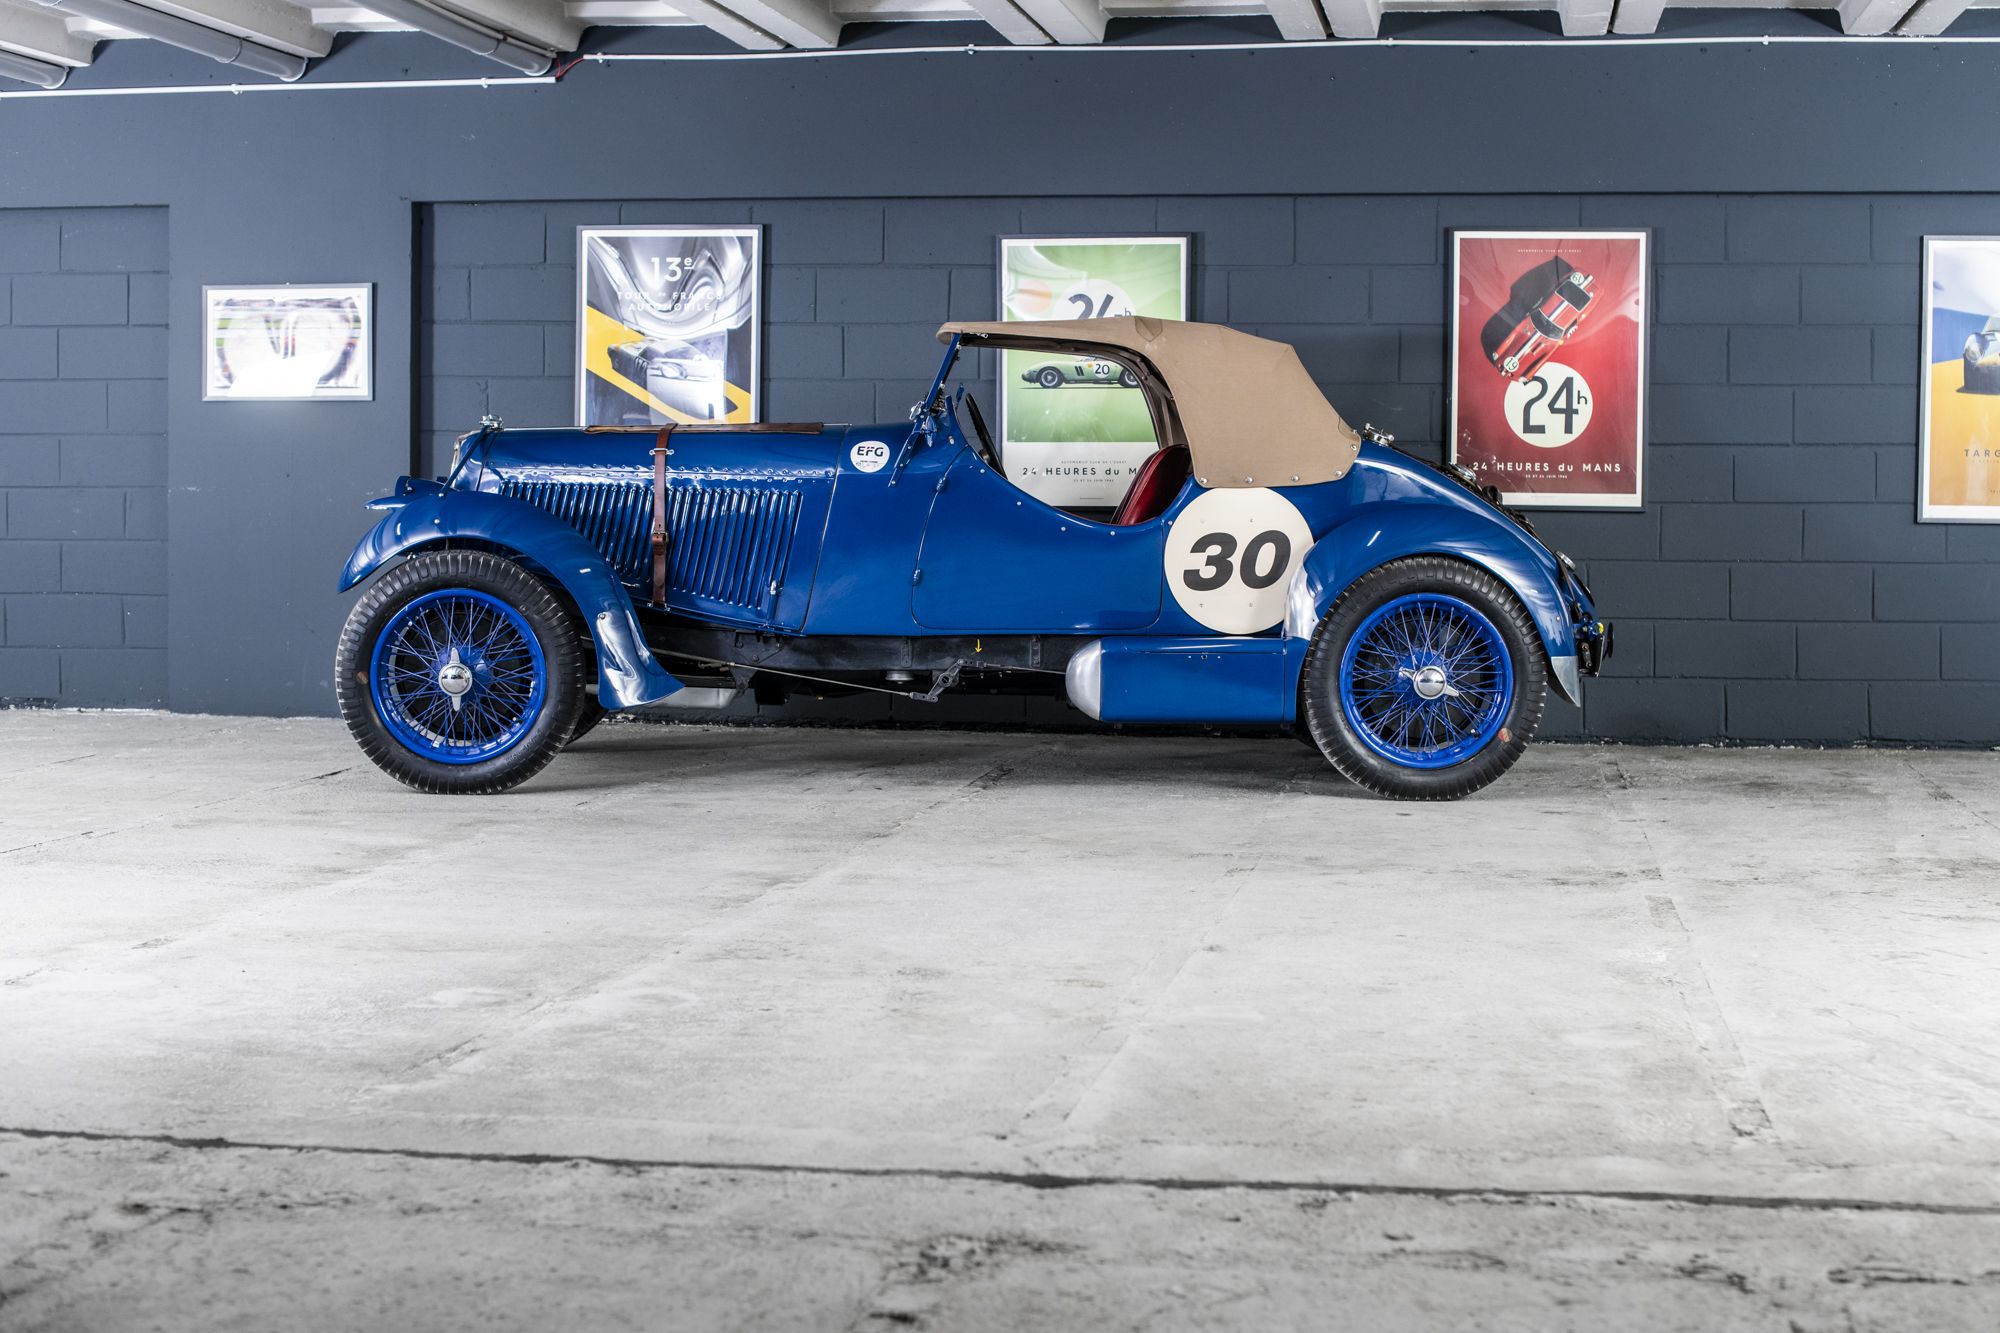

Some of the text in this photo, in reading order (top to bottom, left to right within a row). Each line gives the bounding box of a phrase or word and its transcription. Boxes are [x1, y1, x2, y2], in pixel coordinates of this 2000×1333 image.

[672, 292, 722, 300] FRACE
[628, 303, 710, 311] AUMOBILE
[1095, 363, 1110, 375] 20
[857, 446, 884, 457] EFG
[1022, 467, 1037, 476] 24
[1045, 467, 1097, 476] HEURES
[1105, 467, 1120, 476] du
[1472, 462, 1620, 472] 24 HEURES du MANS
[1183, 529, 1292, 592] 30
